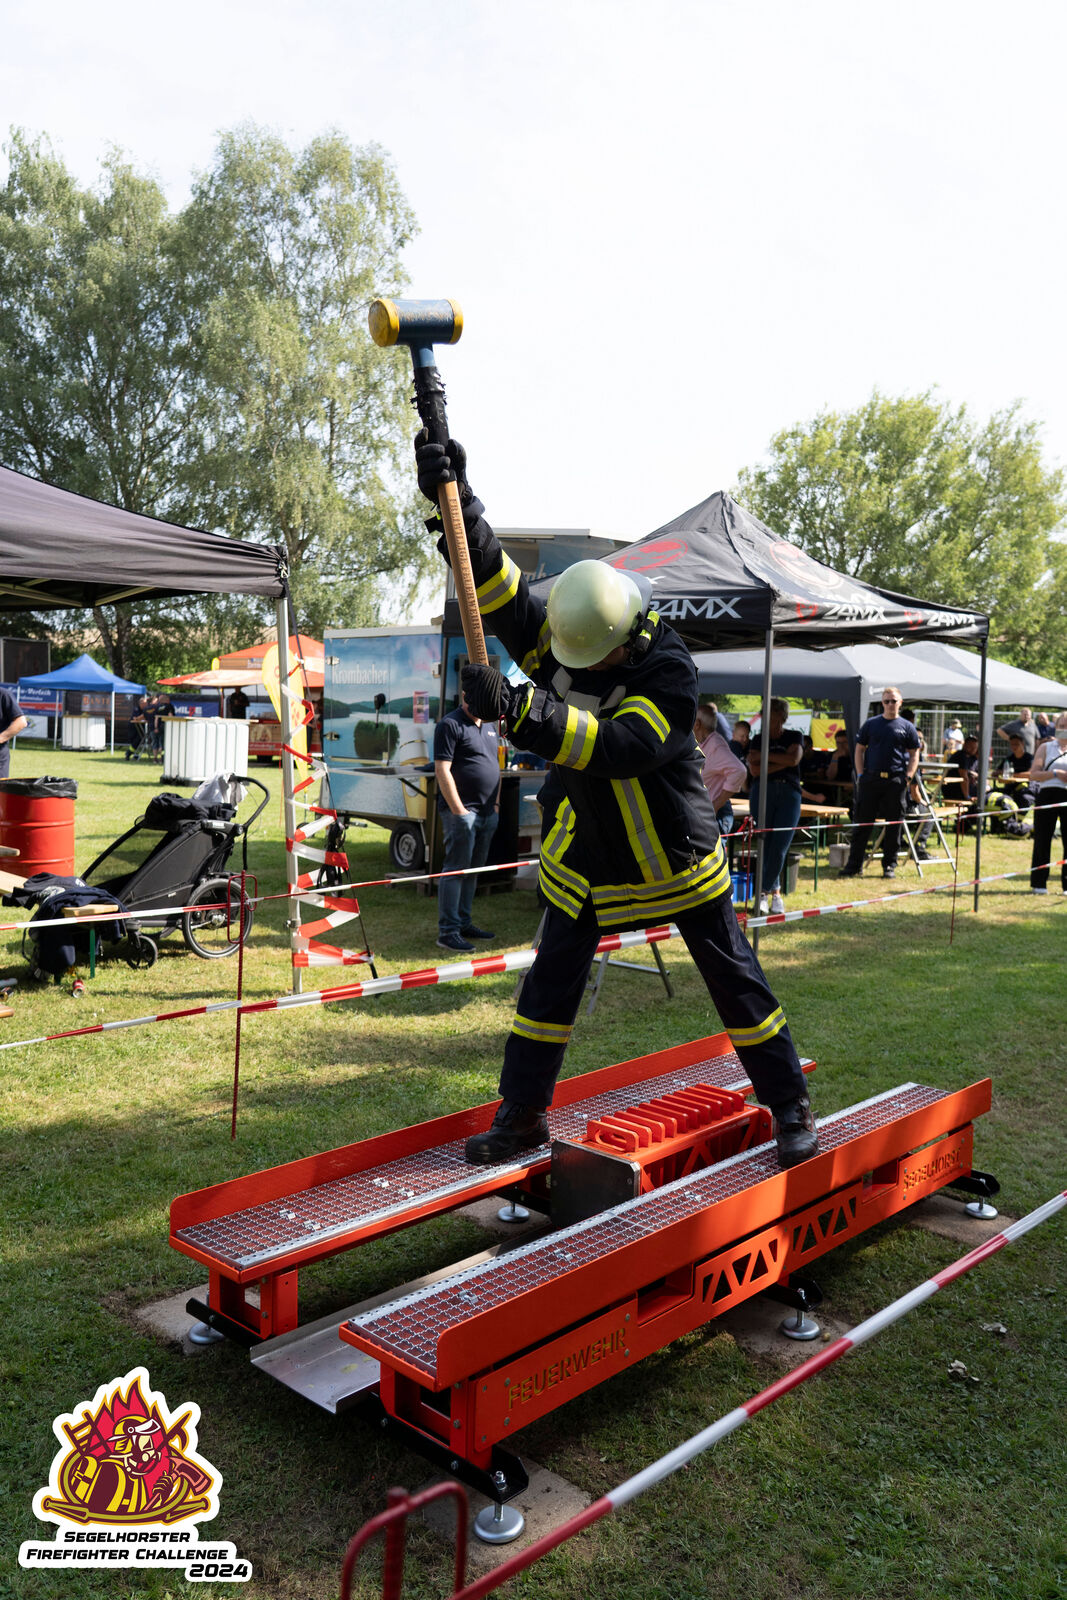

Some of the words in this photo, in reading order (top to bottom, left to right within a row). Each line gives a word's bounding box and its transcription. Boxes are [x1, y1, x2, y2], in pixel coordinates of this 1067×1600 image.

[462, 566, 480, 630] FEUERWEHR
[473, 631, 488, 665] SEGEL
[331, 663, 388, 685] Krombacher
[508, 1328, 626, 1410] FEUERWEHR
